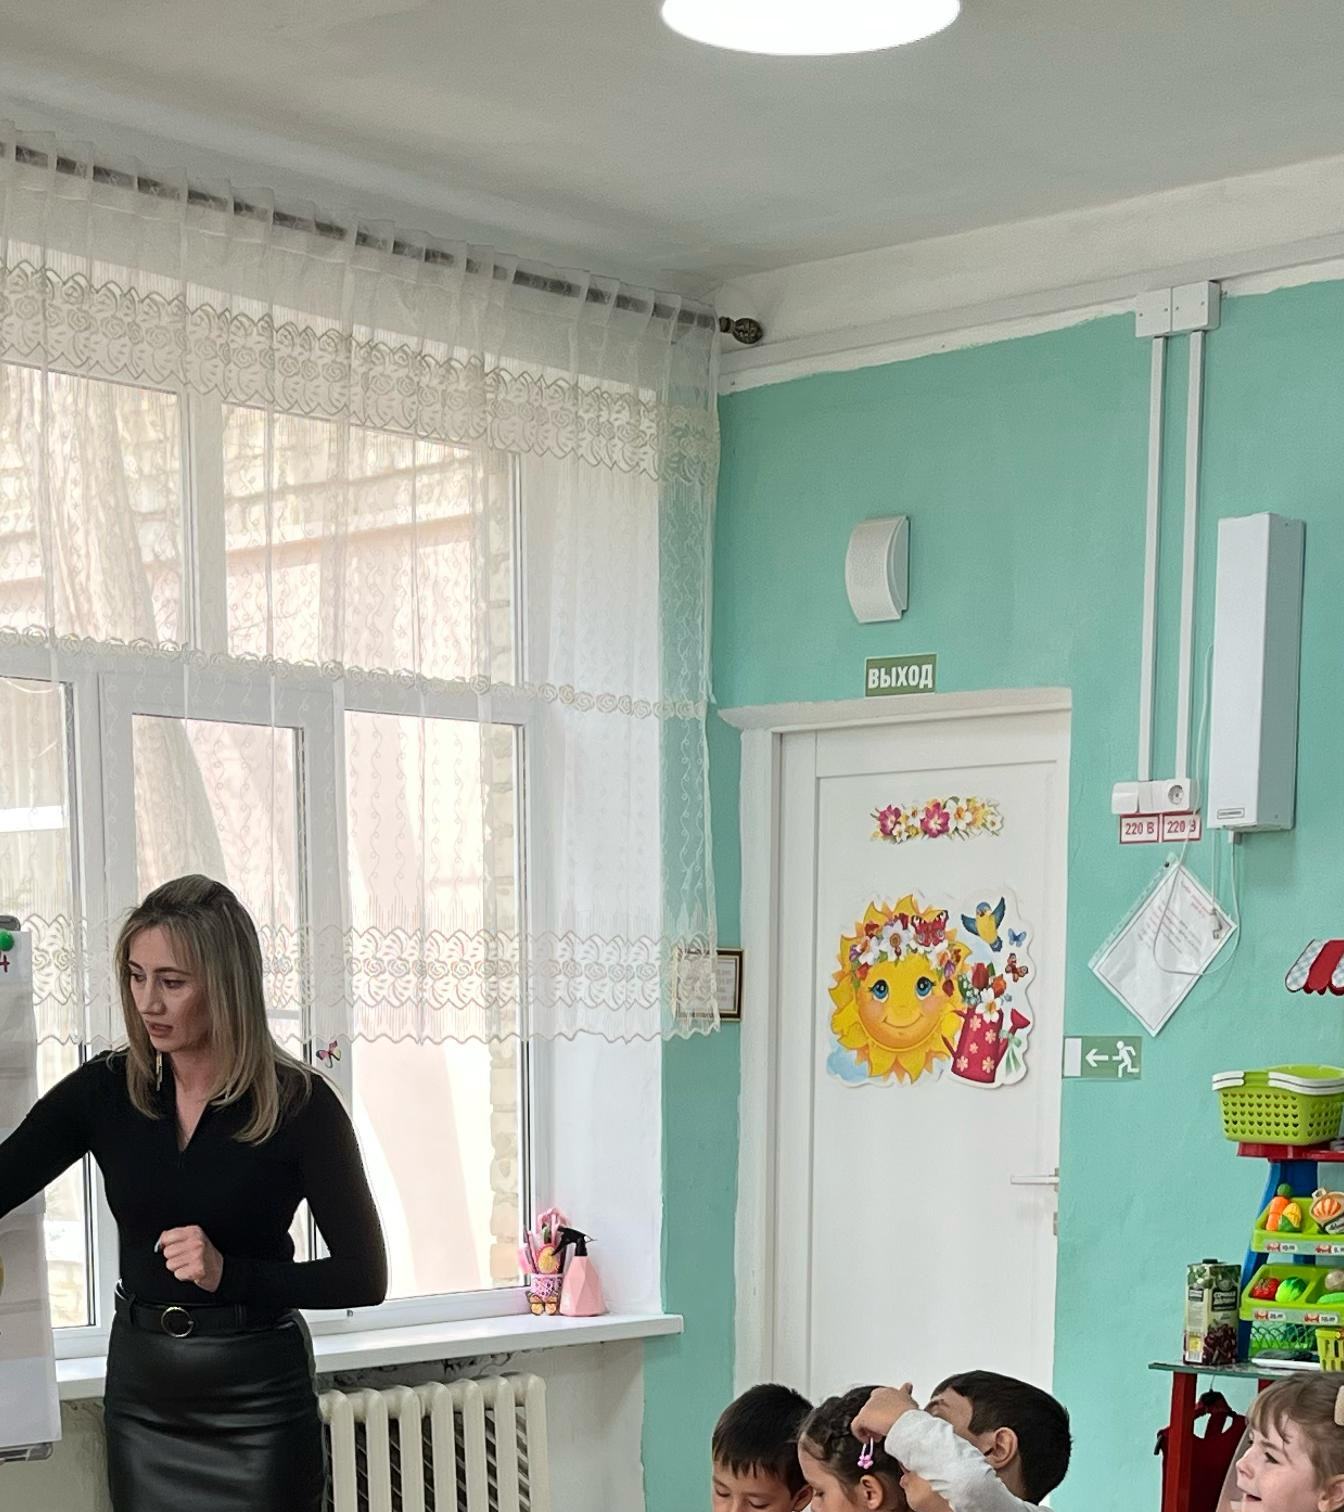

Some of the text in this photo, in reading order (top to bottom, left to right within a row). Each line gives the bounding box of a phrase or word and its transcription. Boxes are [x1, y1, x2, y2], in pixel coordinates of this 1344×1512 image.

[867, 664, 934, 690] ВЫХОД
[1125, 822, 1144, 835] 220
[1166, 820, 1186, 833] 220
